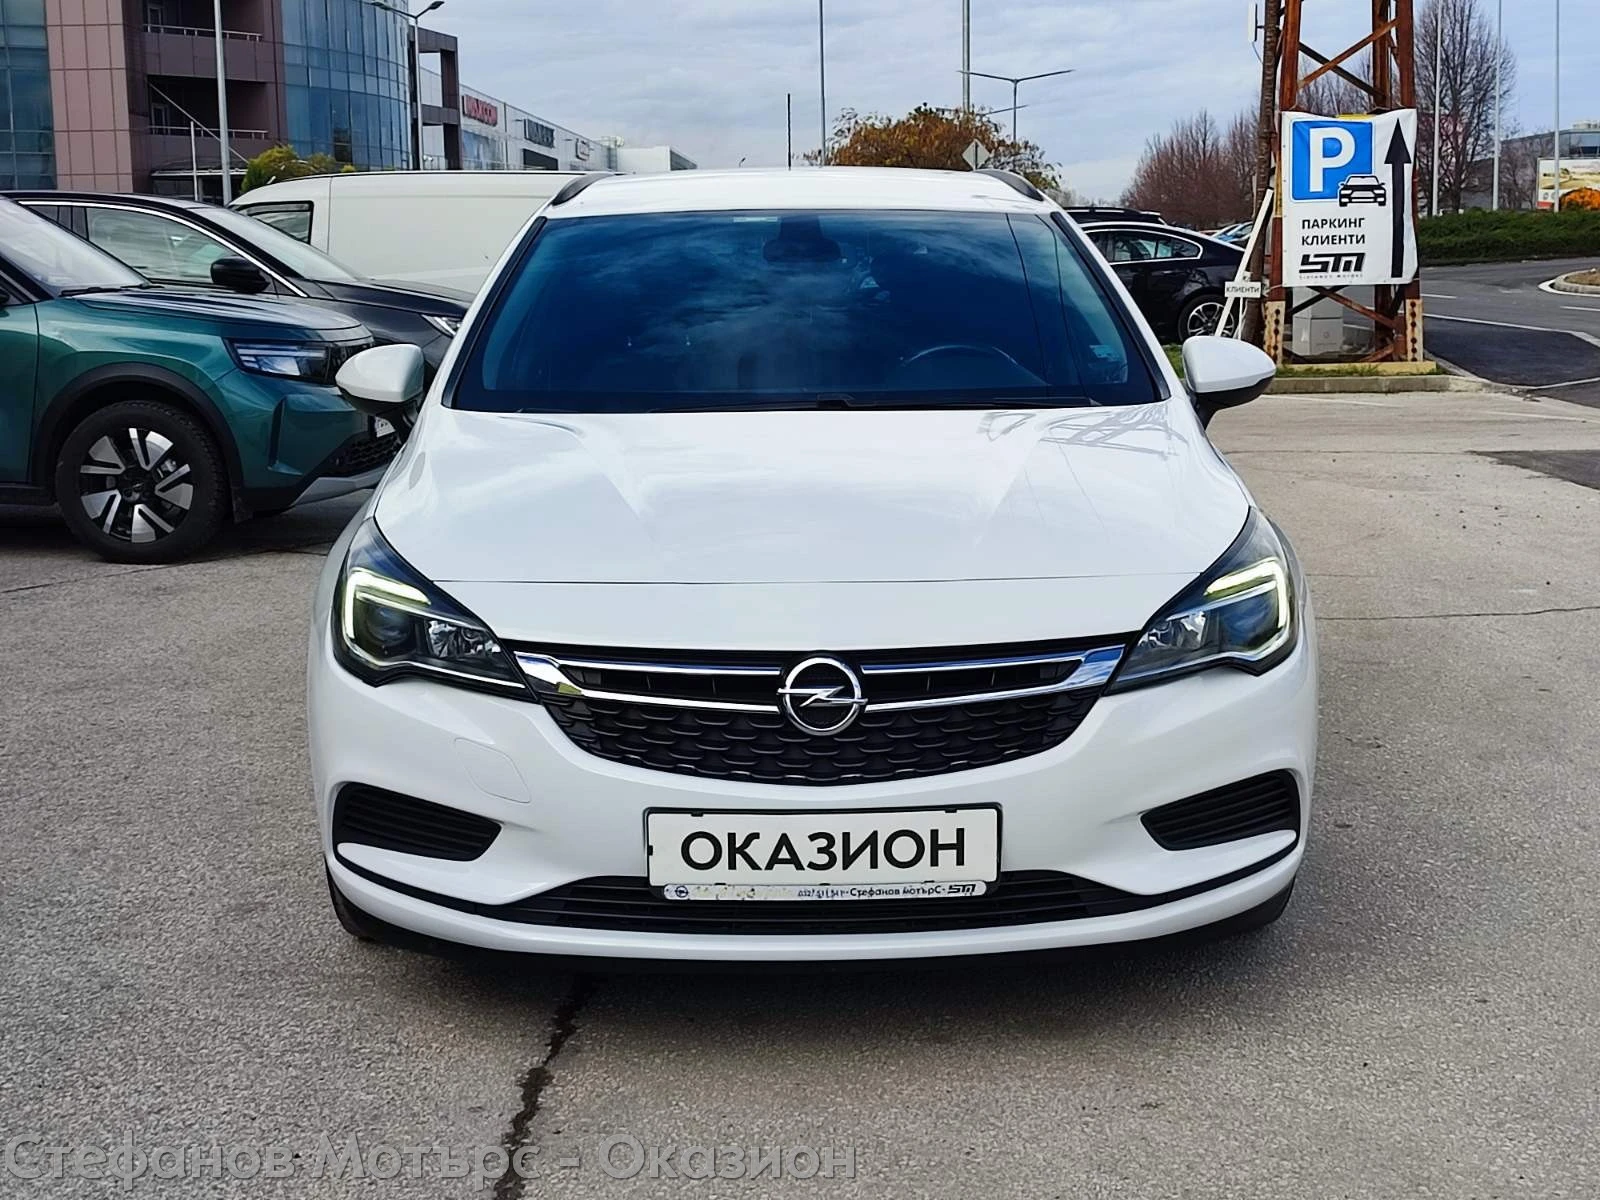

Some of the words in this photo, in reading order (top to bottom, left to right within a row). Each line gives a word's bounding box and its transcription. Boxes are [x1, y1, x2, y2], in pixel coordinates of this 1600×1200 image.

[1309, 127, 1356, 192] P
[1301, 217, 1366, 230] ПАРКИНГ
[1301, 233, 1366, 246] КЛИЕНТИ
[680, 827, 966, 871] ОКАЗИОН
